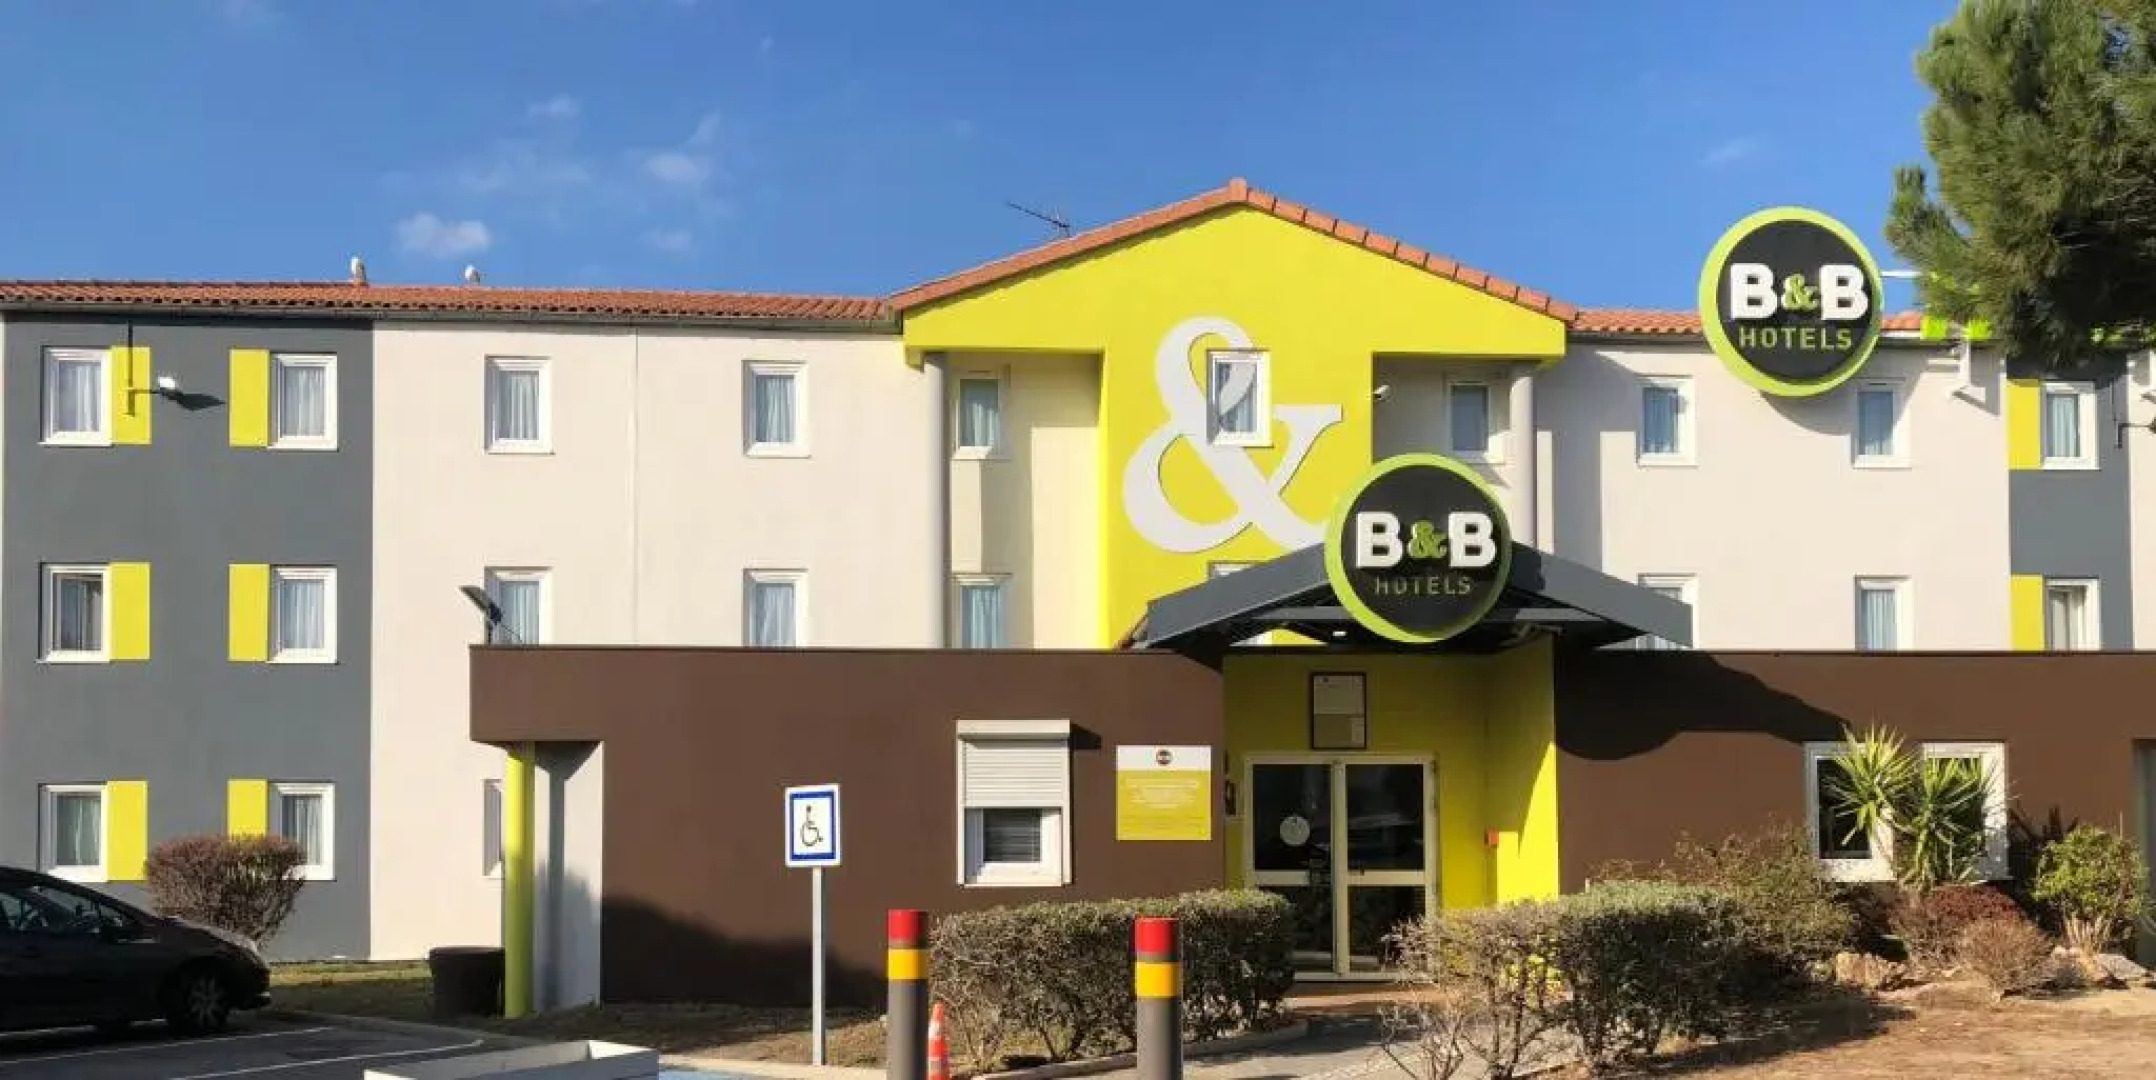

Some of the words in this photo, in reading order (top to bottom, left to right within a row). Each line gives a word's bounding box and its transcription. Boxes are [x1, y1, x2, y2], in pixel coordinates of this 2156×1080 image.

[1731, 263, 1869, 320] B&B
[1739, 327, 1852, 350] HOTELS
[1123, 316, 1342, 552] &
[1356, 511, 1498, 568] B&B
[1375, 576, 1472, 595] HOTELS
